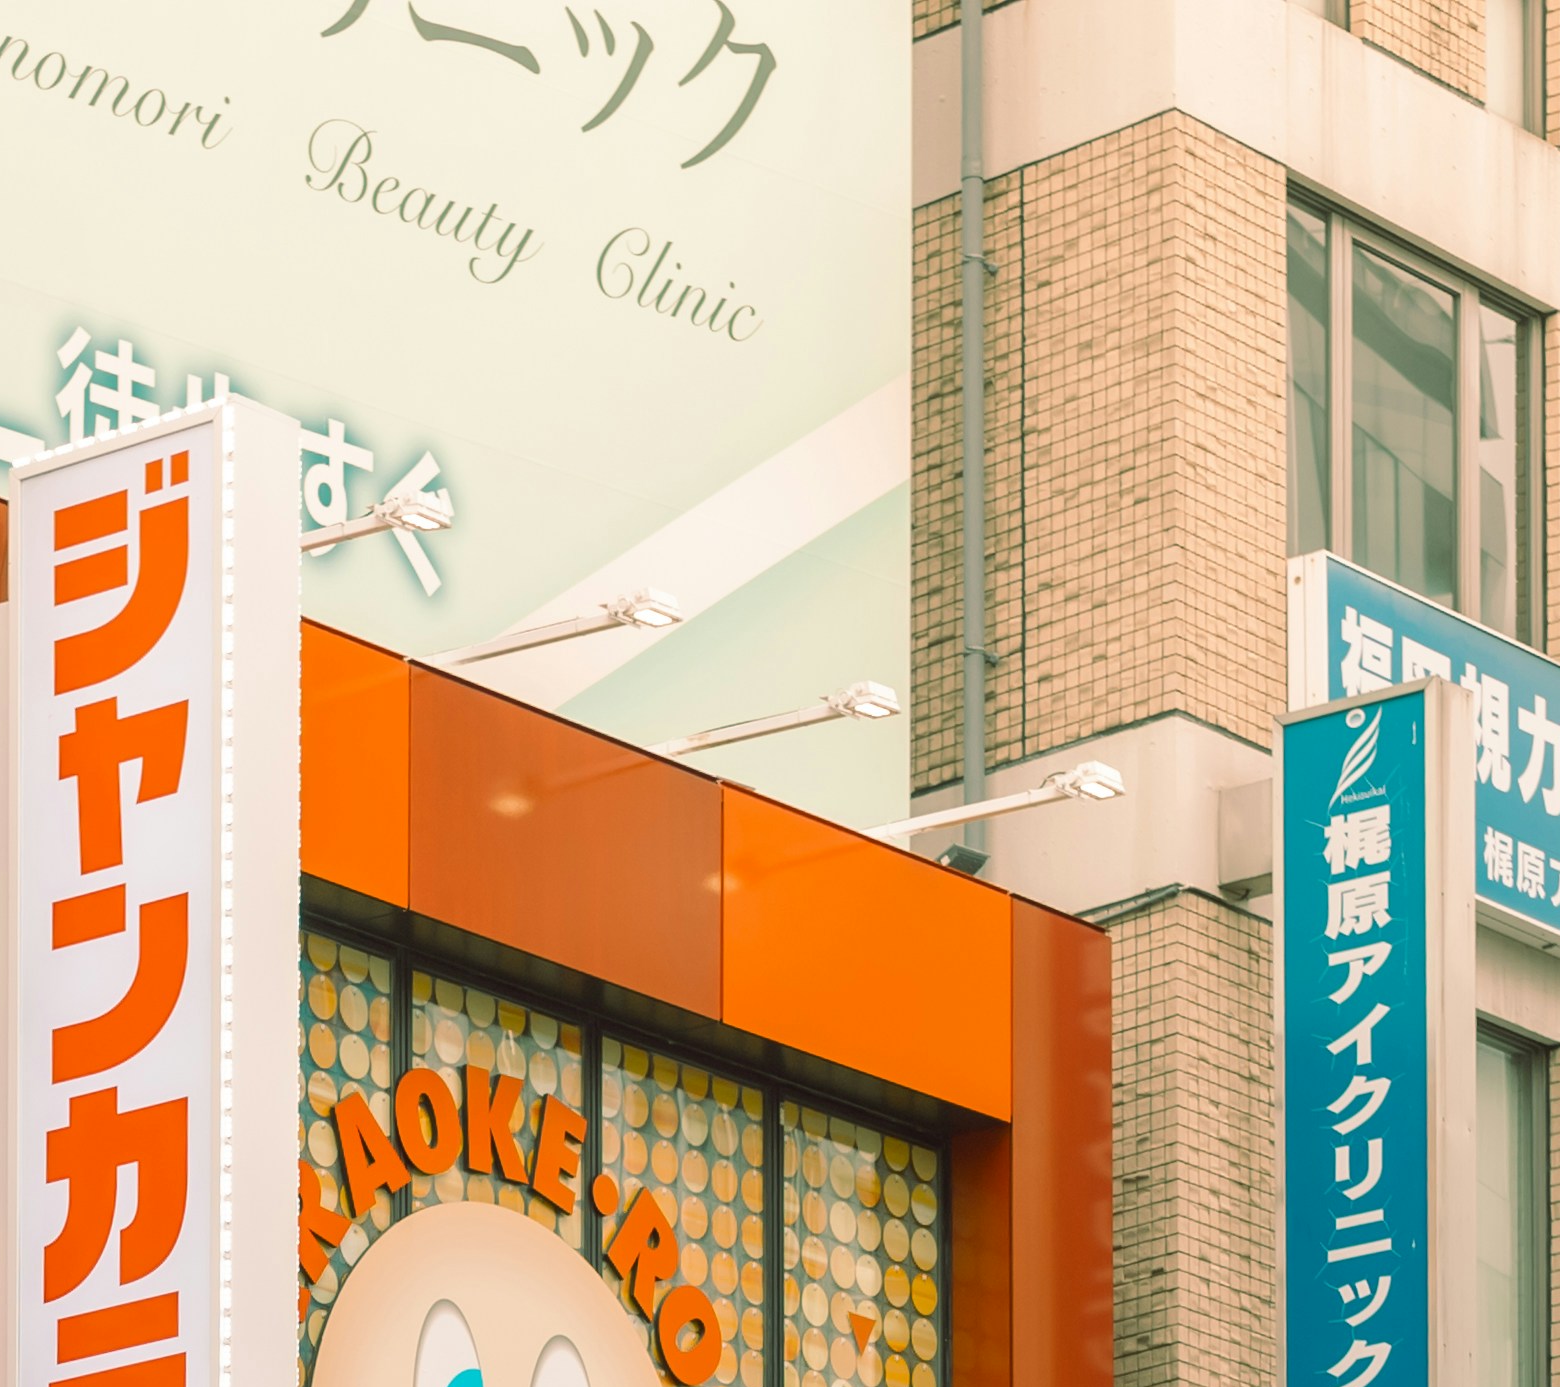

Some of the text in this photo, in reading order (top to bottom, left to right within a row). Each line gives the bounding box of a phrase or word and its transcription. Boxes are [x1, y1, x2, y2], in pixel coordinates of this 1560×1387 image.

[318, 0, 778, 170] ック
[306, 117, 544, 286] Beauty
[595, 226, 765, 344] Clinic
